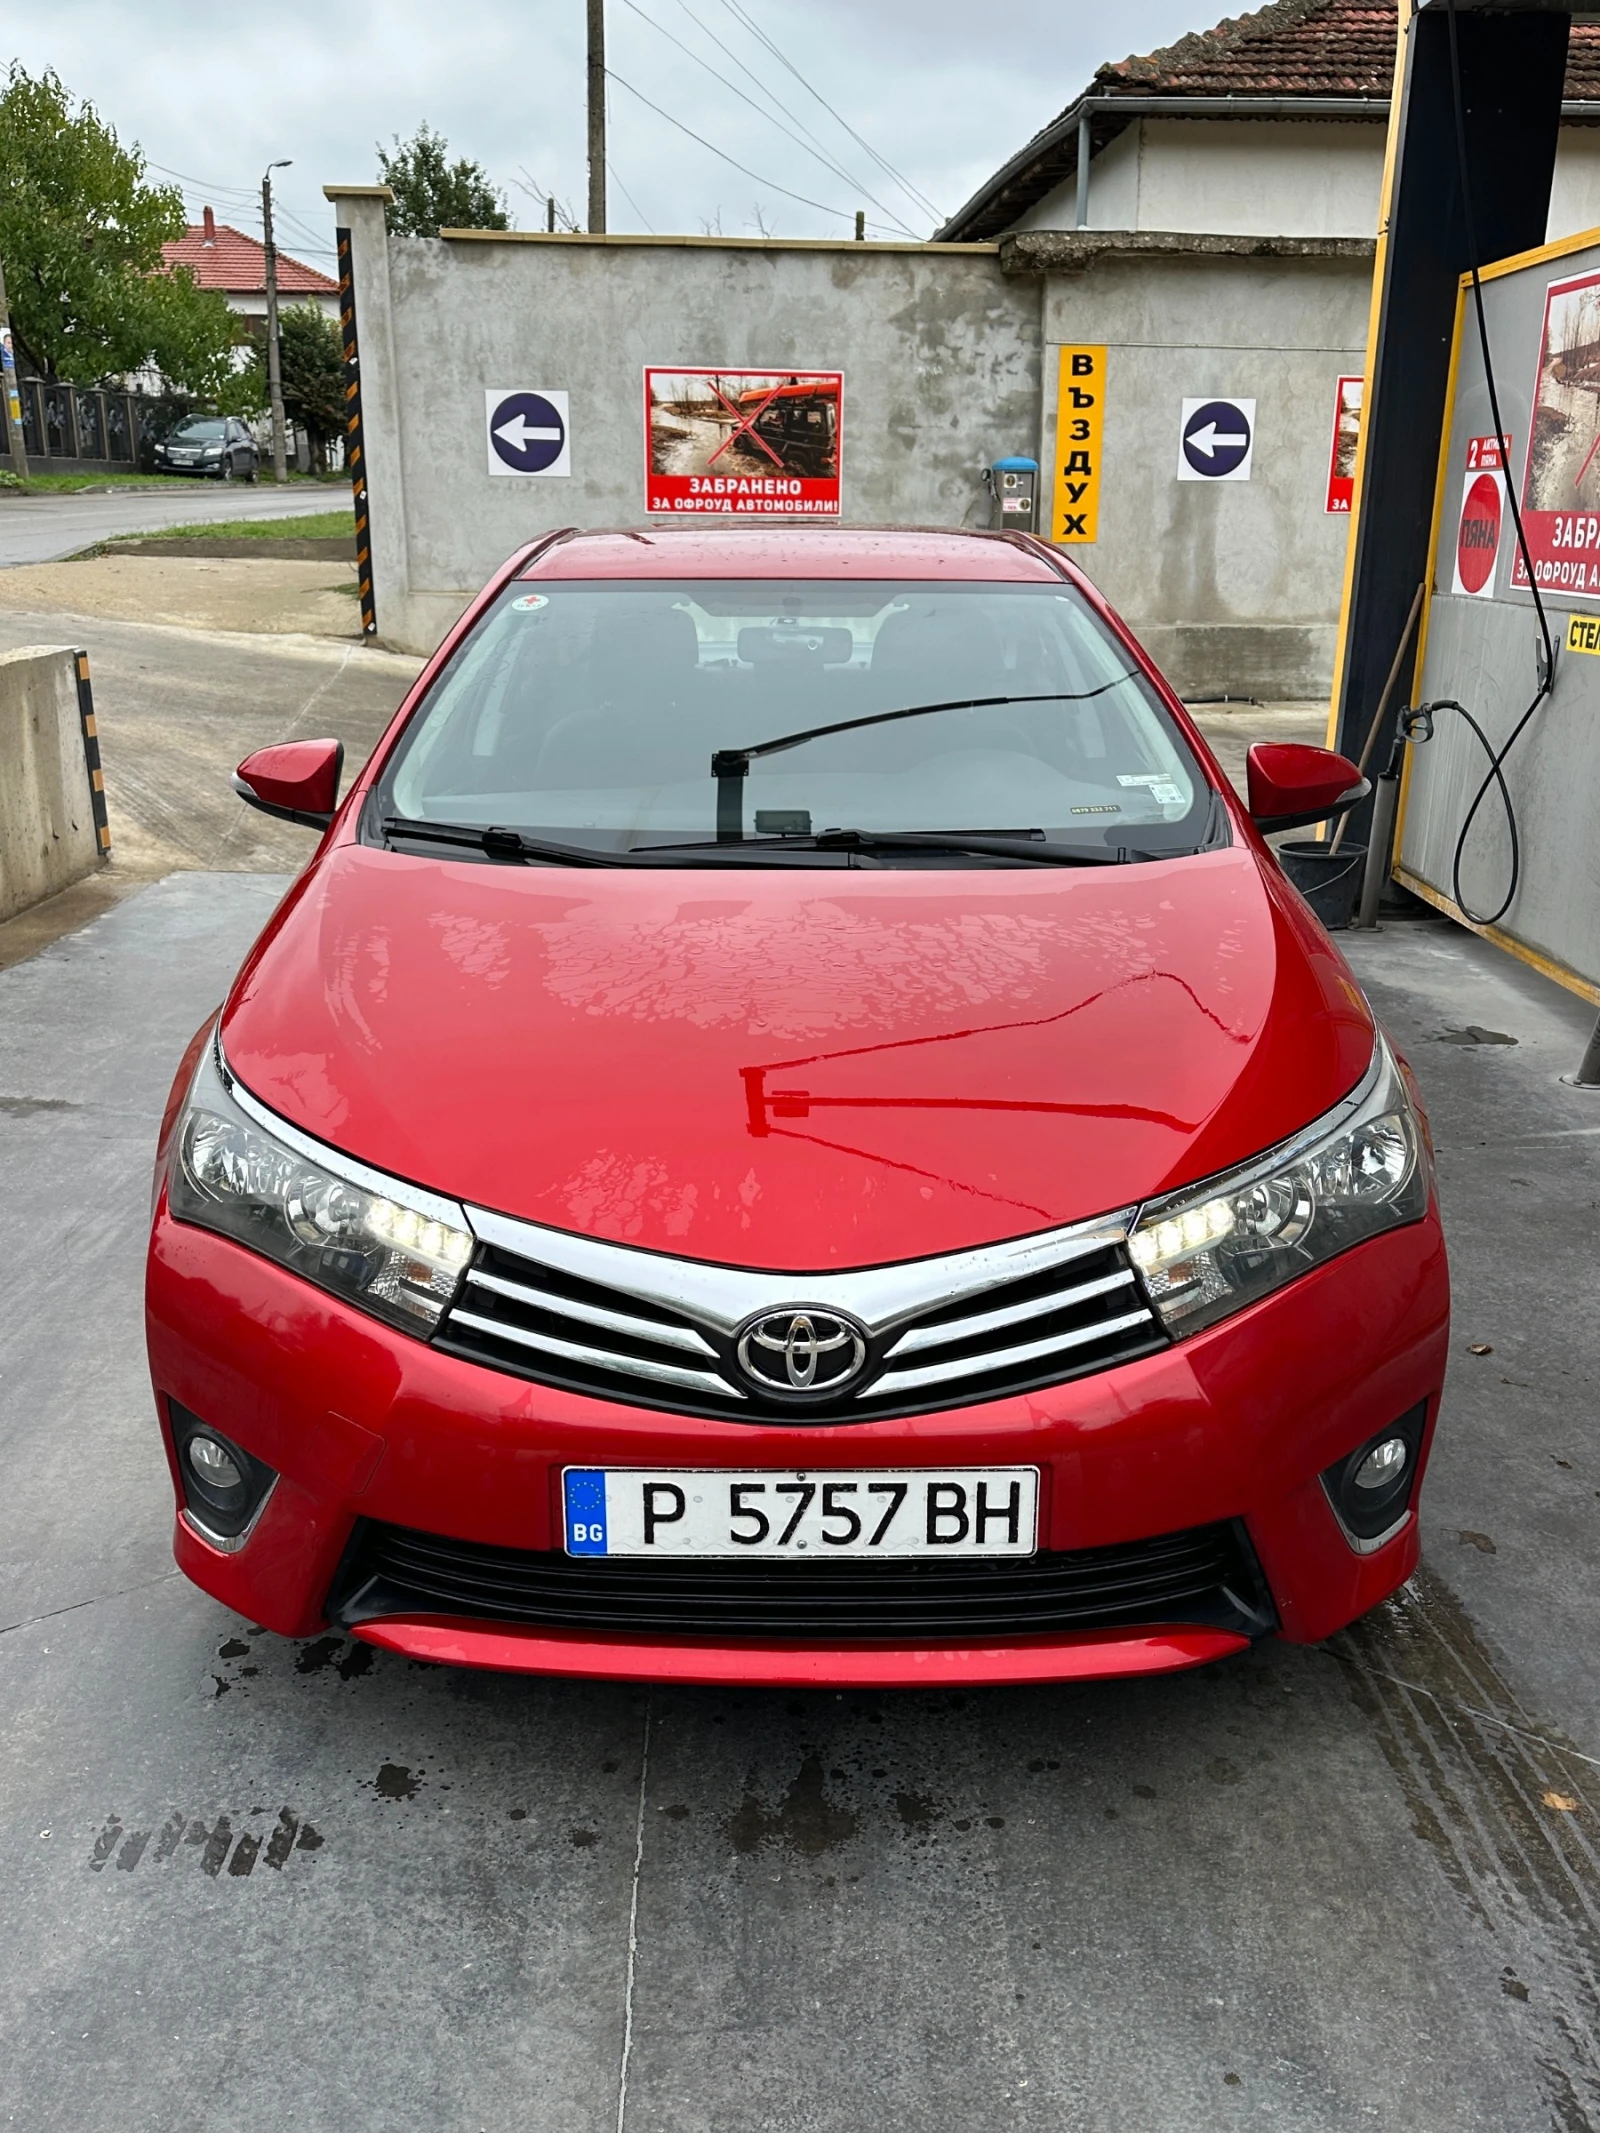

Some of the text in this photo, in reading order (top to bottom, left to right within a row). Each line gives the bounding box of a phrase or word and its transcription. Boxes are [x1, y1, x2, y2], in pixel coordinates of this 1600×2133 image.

[1062, 354, 1095, 535] ВЪЗДУХ
[1468, 439, 1478, 469] 2
[689, 478, 802, 495] ЗАБРАНЕНО
[652, 497, 838, 513] ЗА ОФРОУД АВТОМОБИЛИ!
[1332, 498, 1349, 510] ЗА
[1460, 519, 1495, 549] ПЯНА
[1534, 559, 1587, 589] ОФРОУД
[642, 1480, 1021, 1545] P 5757 BH
[573, 1523, 604, 1542] BG
